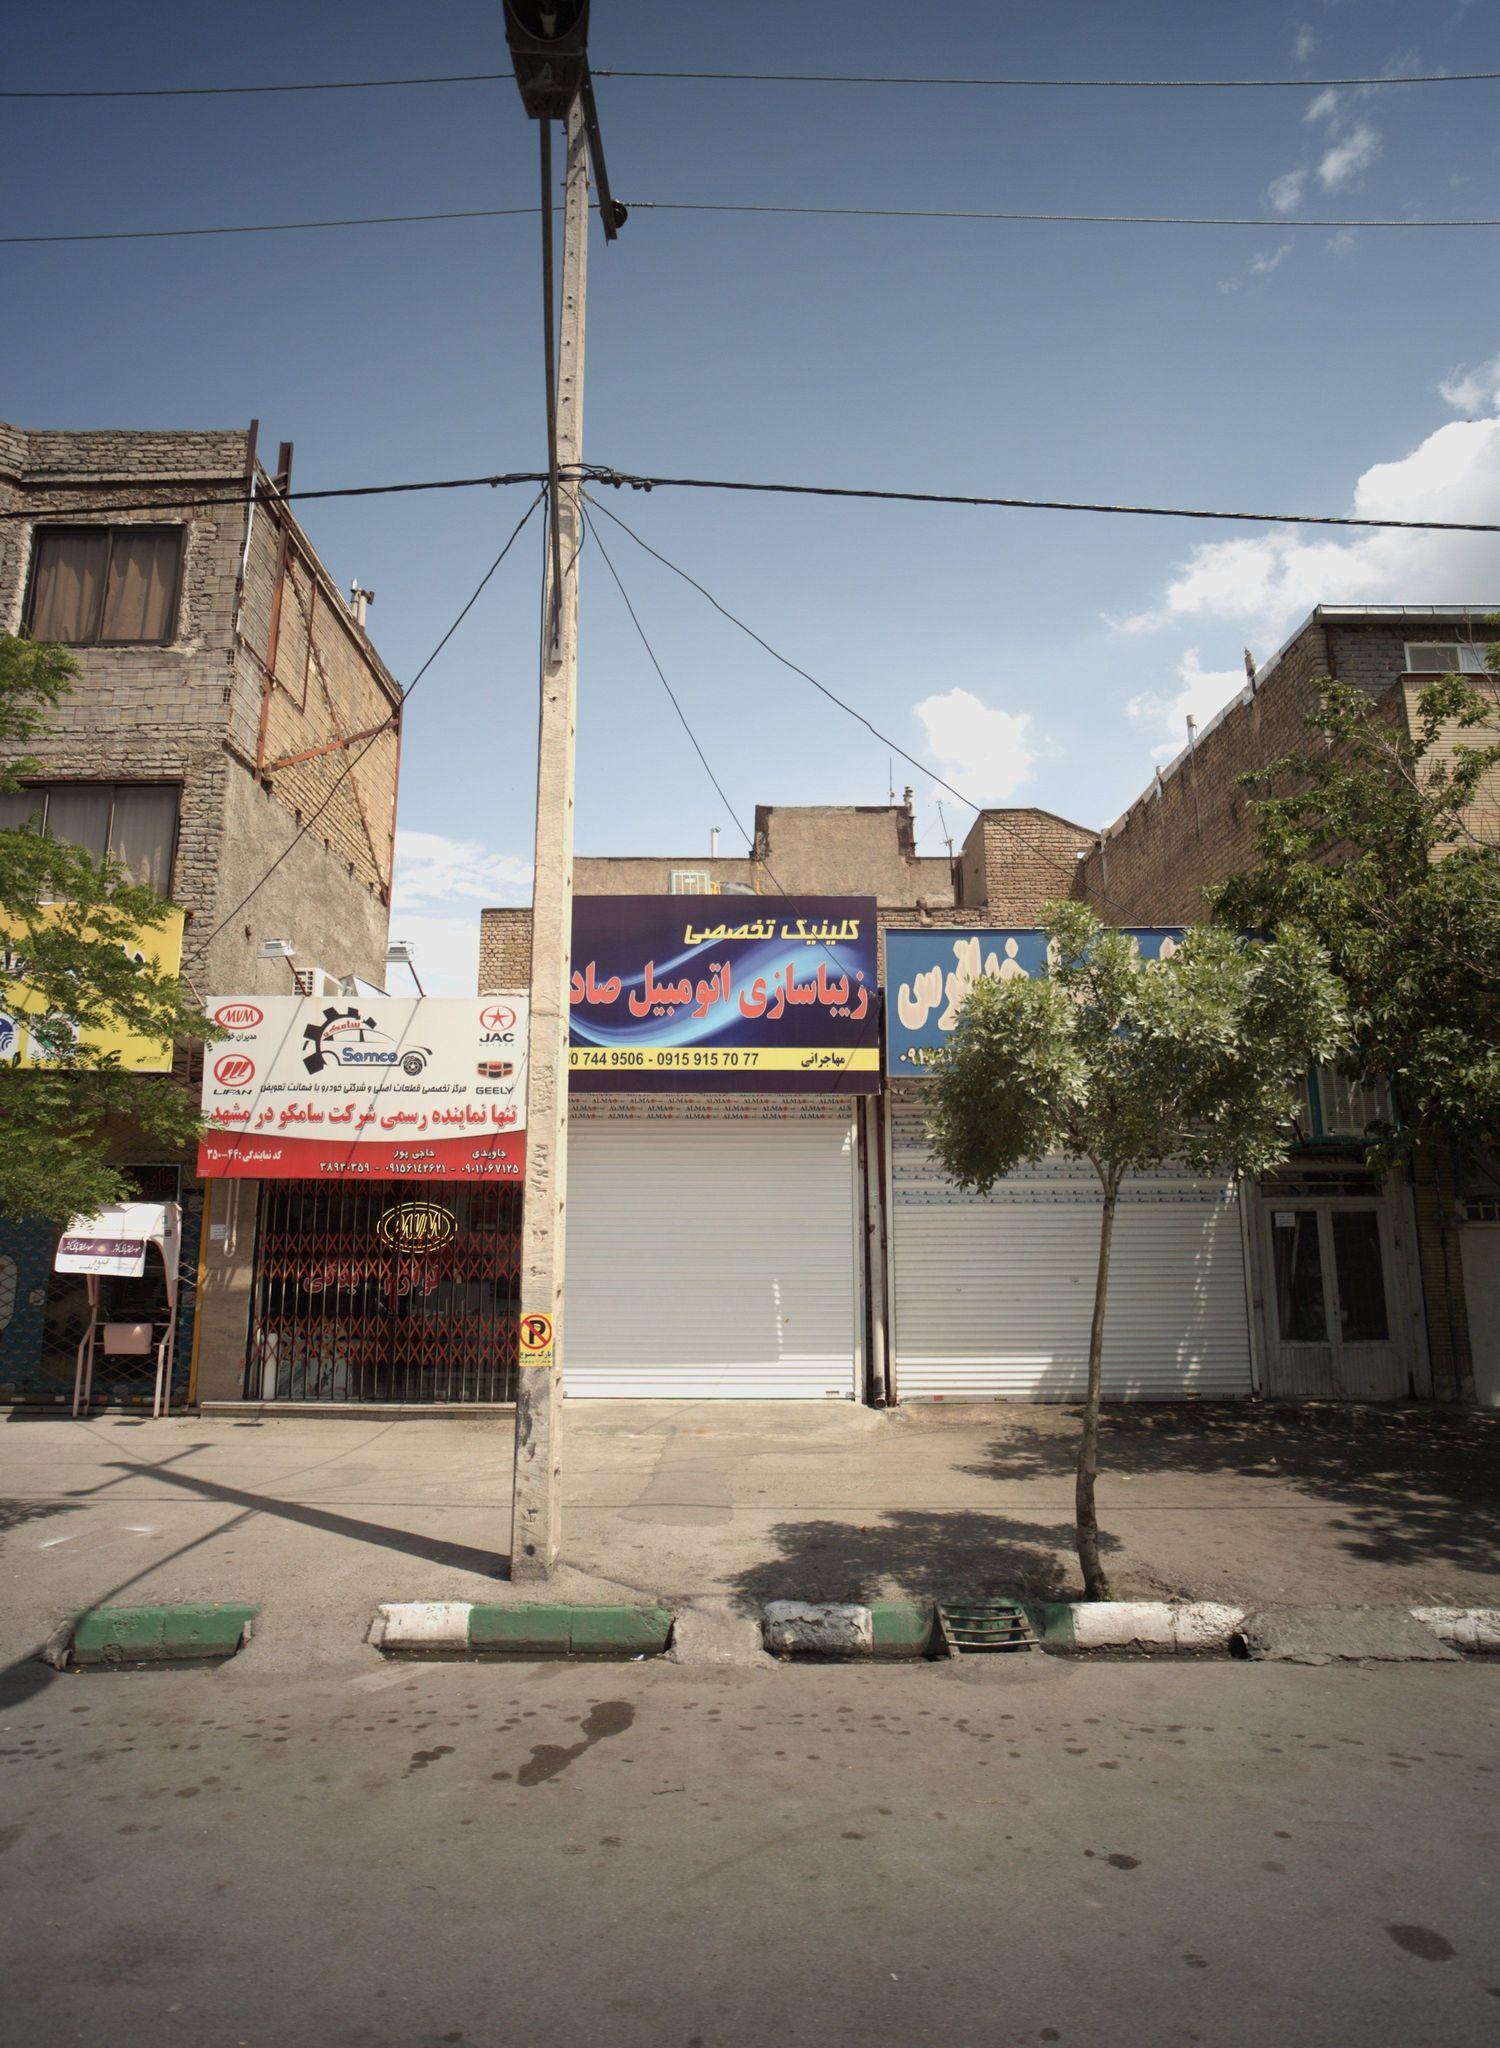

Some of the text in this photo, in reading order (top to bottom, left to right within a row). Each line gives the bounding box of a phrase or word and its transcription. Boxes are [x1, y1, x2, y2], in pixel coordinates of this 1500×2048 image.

[683, 918, 860, 946] کلینیک تخصصی
[570, 960, 868, 1020] زیباسازی اتومبیل صاد
[222, 1008, 254, 1023] MVM
[479, 1032, 514, 1042] JAC
[342, 1047, 398, 1062] Samco
[583, 1052, 607, 1065] 744
[612, 1052, 644, 1065] 9506
[657, 1052, 690, 1065] 0915
[694, 1052, 718, 1065] 915
[723, 1052, 738, 1065] 70
[743, 1052, 759, 1066] 77
[801, 1052, 846, 1068] مهاجرانی
[260, 1083, 286, 1093] تعویض
[287, 1082, 312, 1092] ضمانت
[314, 1082, 320, 1092] با
[321, 1083, 342, 1093] خودرو
[344, 1082, 366, 1094] شرکتی
[373, 1083, 392, 1094] اصلی
[393, 1082, 420, 1093] قطعات
[422, 1083, 450, 1094] تخصصی
[452, 1083, 467, 1094] مرکز
[475, 1086, 514, 1095] GEELY
[210, 1102, 518, 1131] تنها نماینده رسمی شرکت سامکو در مشهد
[272, 1149, 282, 1160] کد
[393, 1147, 435, 1159] حاجی پور
[471, 1148, 507, 1159] جاویدی
